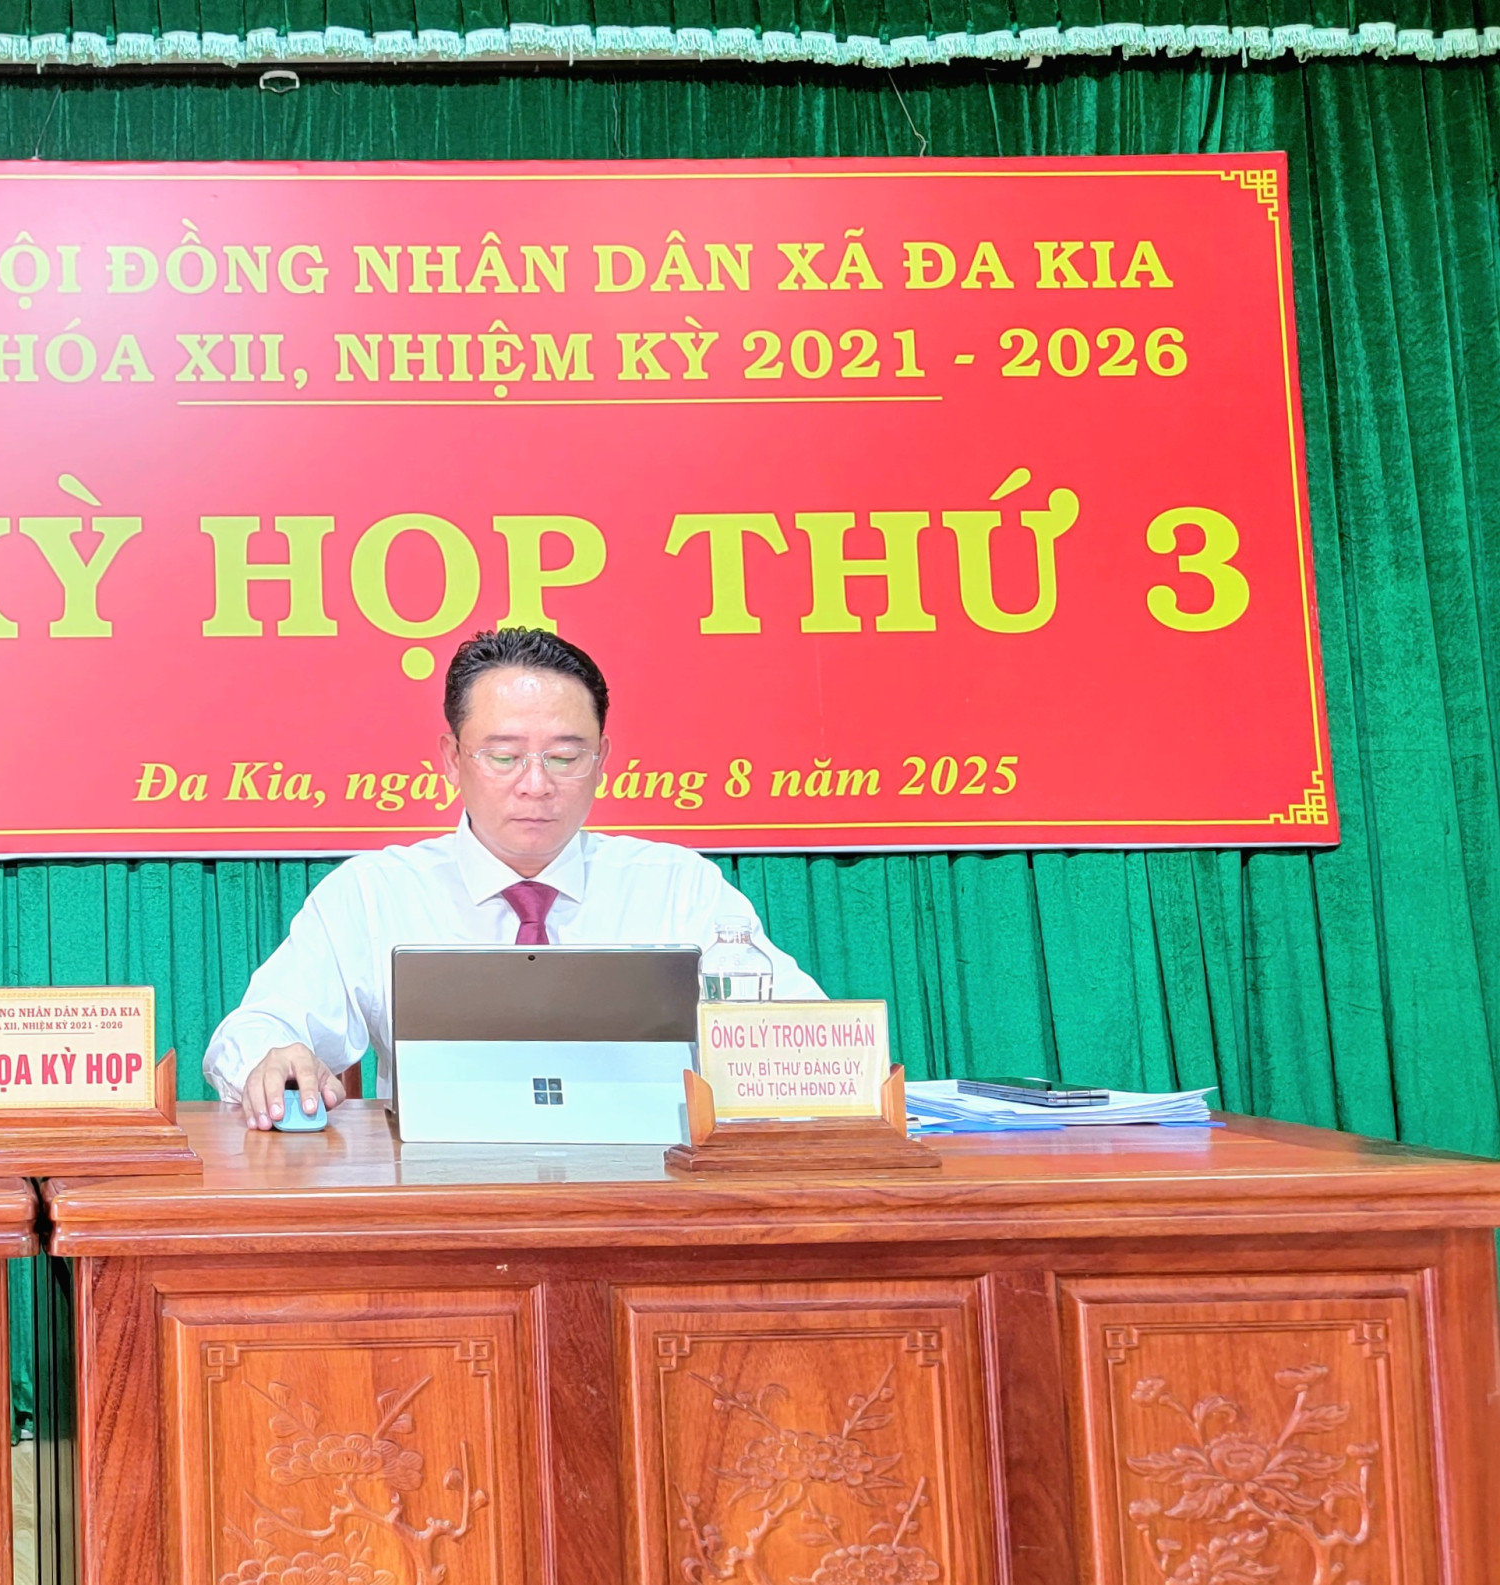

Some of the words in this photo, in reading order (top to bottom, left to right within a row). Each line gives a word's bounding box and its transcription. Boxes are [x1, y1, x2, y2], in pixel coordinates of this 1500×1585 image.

[105, 218, 330, 294] ĐỒNG
[353, 231, 568, 293] NHÂN
[593, 230, 753, 293] DÂN
[777, 227, 883, 291] XÃ
[902, 241, 1014, 290] ĐA
[1034, 240, 1174, 289] KIA
[175, 333, 308, 390] XII,
[334, 319, 593, 397] NHIỆM
[616, 316, 719, 381] KỲ
[742, 329, 926, 379] 2021
[954, 354, 975, 365] -
[999, 327, 1188, 377] 2026
[201, 512, 607, 681] HỌP
[664, 467, 1080, 635] THỨ
[1146, 506, 1252, 633] 3
[132, 763, 208, 801] Đa
[222, 761, 326, 808] Kia,
[345, 760, 460, 811] ngày
[724, 758, 753, 798] 8
[770, 757, 880, 797] năm
[898, 755, 1019, 796] 2025
[19, 1006, 51, 1018] NHÂN
[54, 1005, 79, 1017] DÂN
[81, 1005, 98, 1017] XÃ
[100, 1007, 117, 1017] ĐA
[120, 1007, 141, 1017] KIA
[22, 1021, 53, 1032] NHIỆM
[55, 1020, 68, 1030] KỲ
[70, 1021, 92, 1030] 2021
[100, 1021, 123, 1030] 2026
[711, 1019, 745, 1048] ÔNG
[750, 1019, 768, 1048] LÝ
[772, 1024, 827, 1053] TRỌNG
[831, 1017, 875, 1047] NHÂN
[41, 1046, 76, 1085] KỲ
[86, 1053, 142, 1091] HỌP
[727, 1062, 756, 1078] TUV,
[759, 1058, 771, 1076] BÍ
[774, 1061, 801, 1076] THƯ
[804, 1058, 841, 1075] ĐẢNG
[737, 1080, 764, 1096] CHỦ
[767, 1082, 797, 1100] TỊCH
[800, 1082, 836, 1096] HĐND
[839, 1079, 857, 1096] XÃ
